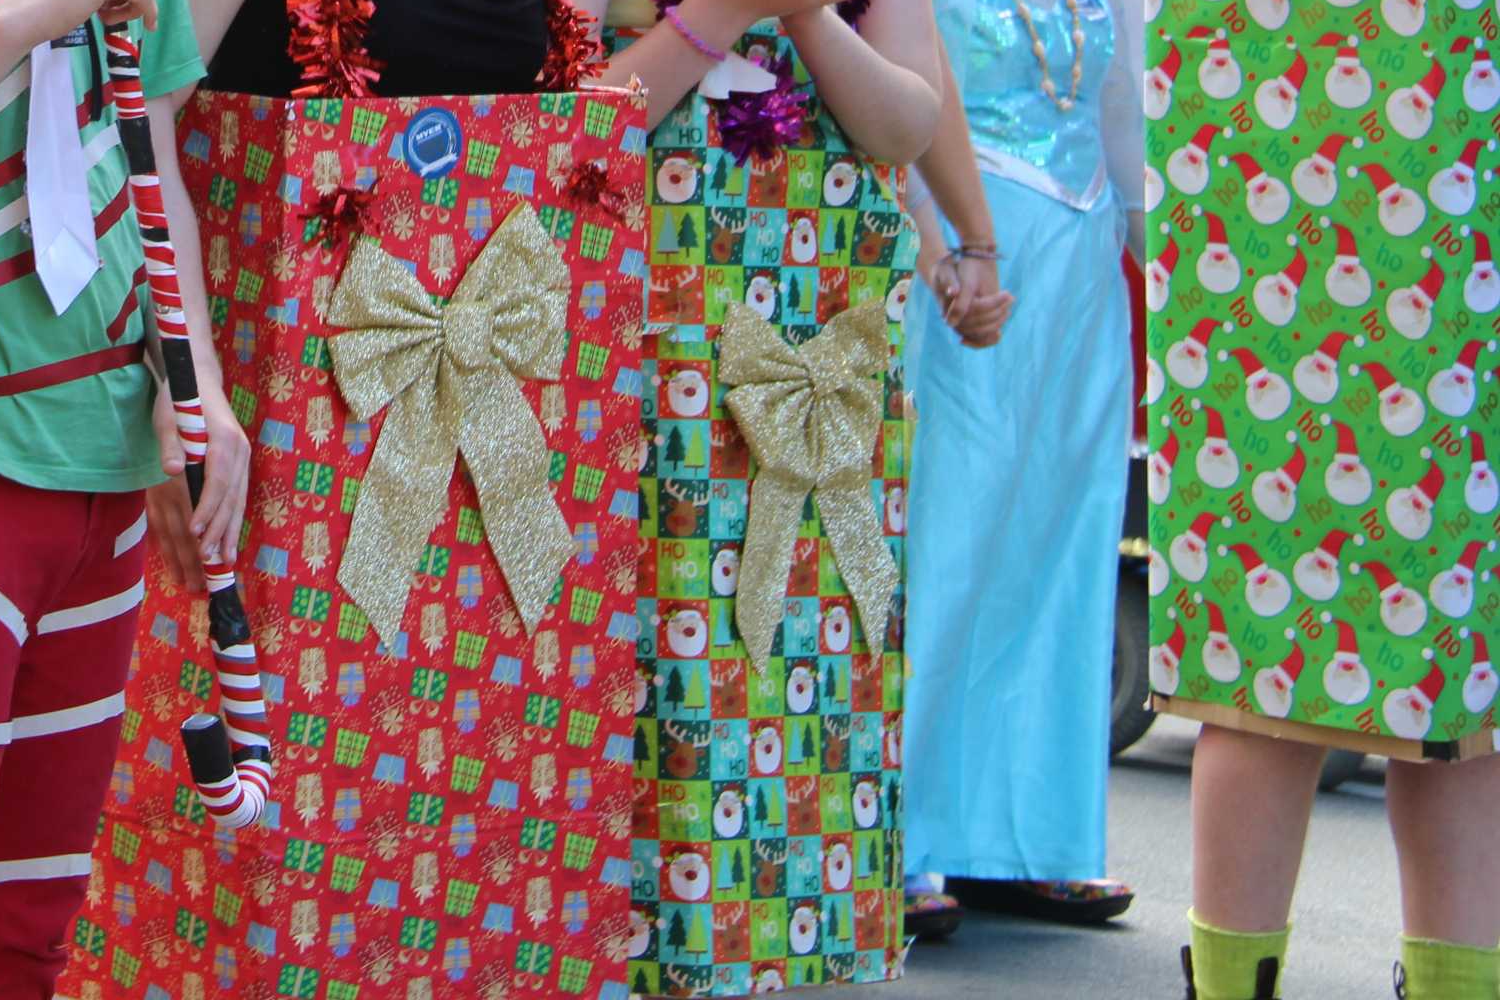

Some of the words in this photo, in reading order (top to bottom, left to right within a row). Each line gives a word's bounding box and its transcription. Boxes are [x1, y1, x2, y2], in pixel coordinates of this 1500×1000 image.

[1221, 2, 1245, 33] ho
[1354, 8, 1380, 41] ho
[1479, 8, 1498, 41] ho
[1230, 102, 1252, 133] ho
[1359, 110, 1385, 143] ho
[679, 129, 702, 144] HO
[790, 154, 806, 169] HO
[750, 212, 768, 227] HO
[1170, 201, 1194, 233] ho
[1297, 212, 1322, 245] ho
[762, 248, 779, 263] HO
[1432, 223, 1462, 256] ho
[707, 270, 724, 285] HO
[1229, 296, 1252, 328] ho
[1360, 309, 1385, 342] ho
[1170, 394, 1193, 427] ho
[1297, 409, 1323, 442] ho
[1432, 424, 1462, 456] ho
[1228, 491, 1251, 523] ho
[728, 520, 744, 536] HO
[1360, 508, 1385, 541] ho
[661, 542, 684, 559] HO
[672, 561, 698, 578] HO
[1176, 588, 1196, 619] ho
[1297, 606, 1323, 640] ho
[1433, 625, 1460, 658] ho
[632, 880, 654, 896] HO
